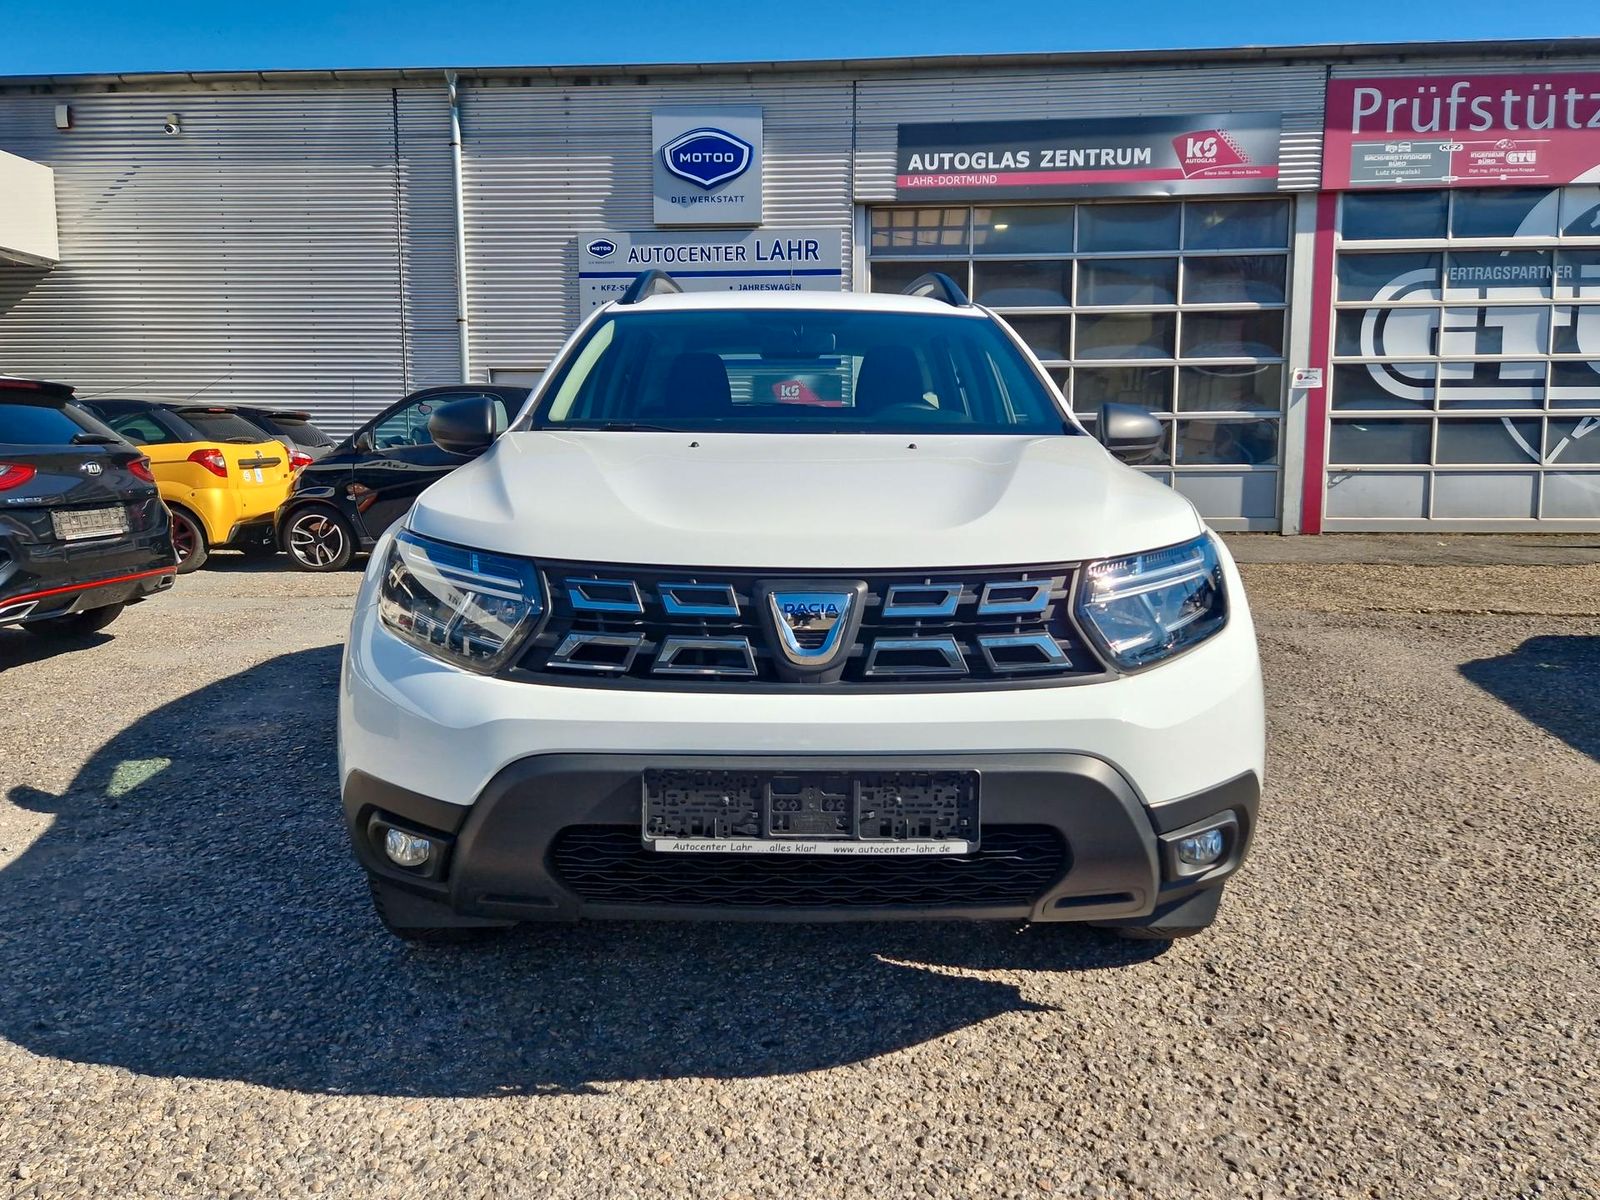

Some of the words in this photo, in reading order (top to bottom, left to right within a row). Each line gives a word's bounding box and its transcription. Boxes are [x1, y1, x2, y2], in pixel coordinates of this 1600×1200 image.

[680, 152, 734, 163] MOTOO
[908, 151, 1030, 171] AUTOGLAS
[1040, 147, 1151, 168] ZENTRUM
[907, 175, 997, 187] LAHR-DORTMUND
[671, 196, 687, 204] DIE
[690, 195, 745, 203] WERKSTATT
[628, 246, 747, 264] AUTOCENTER
[755, 240, 820, 261] LAHR
[739, 283, 802, 291] JAHRESWAGEN
[87, 462, 101, 473] KIA
[784, 603, 838, 613] DACIA
[673, 842, 726, 851] Autocenter
[731, 842, 752, 851] Lahr
[833, 844, 951, 854] www.autocenter-lahr.de
